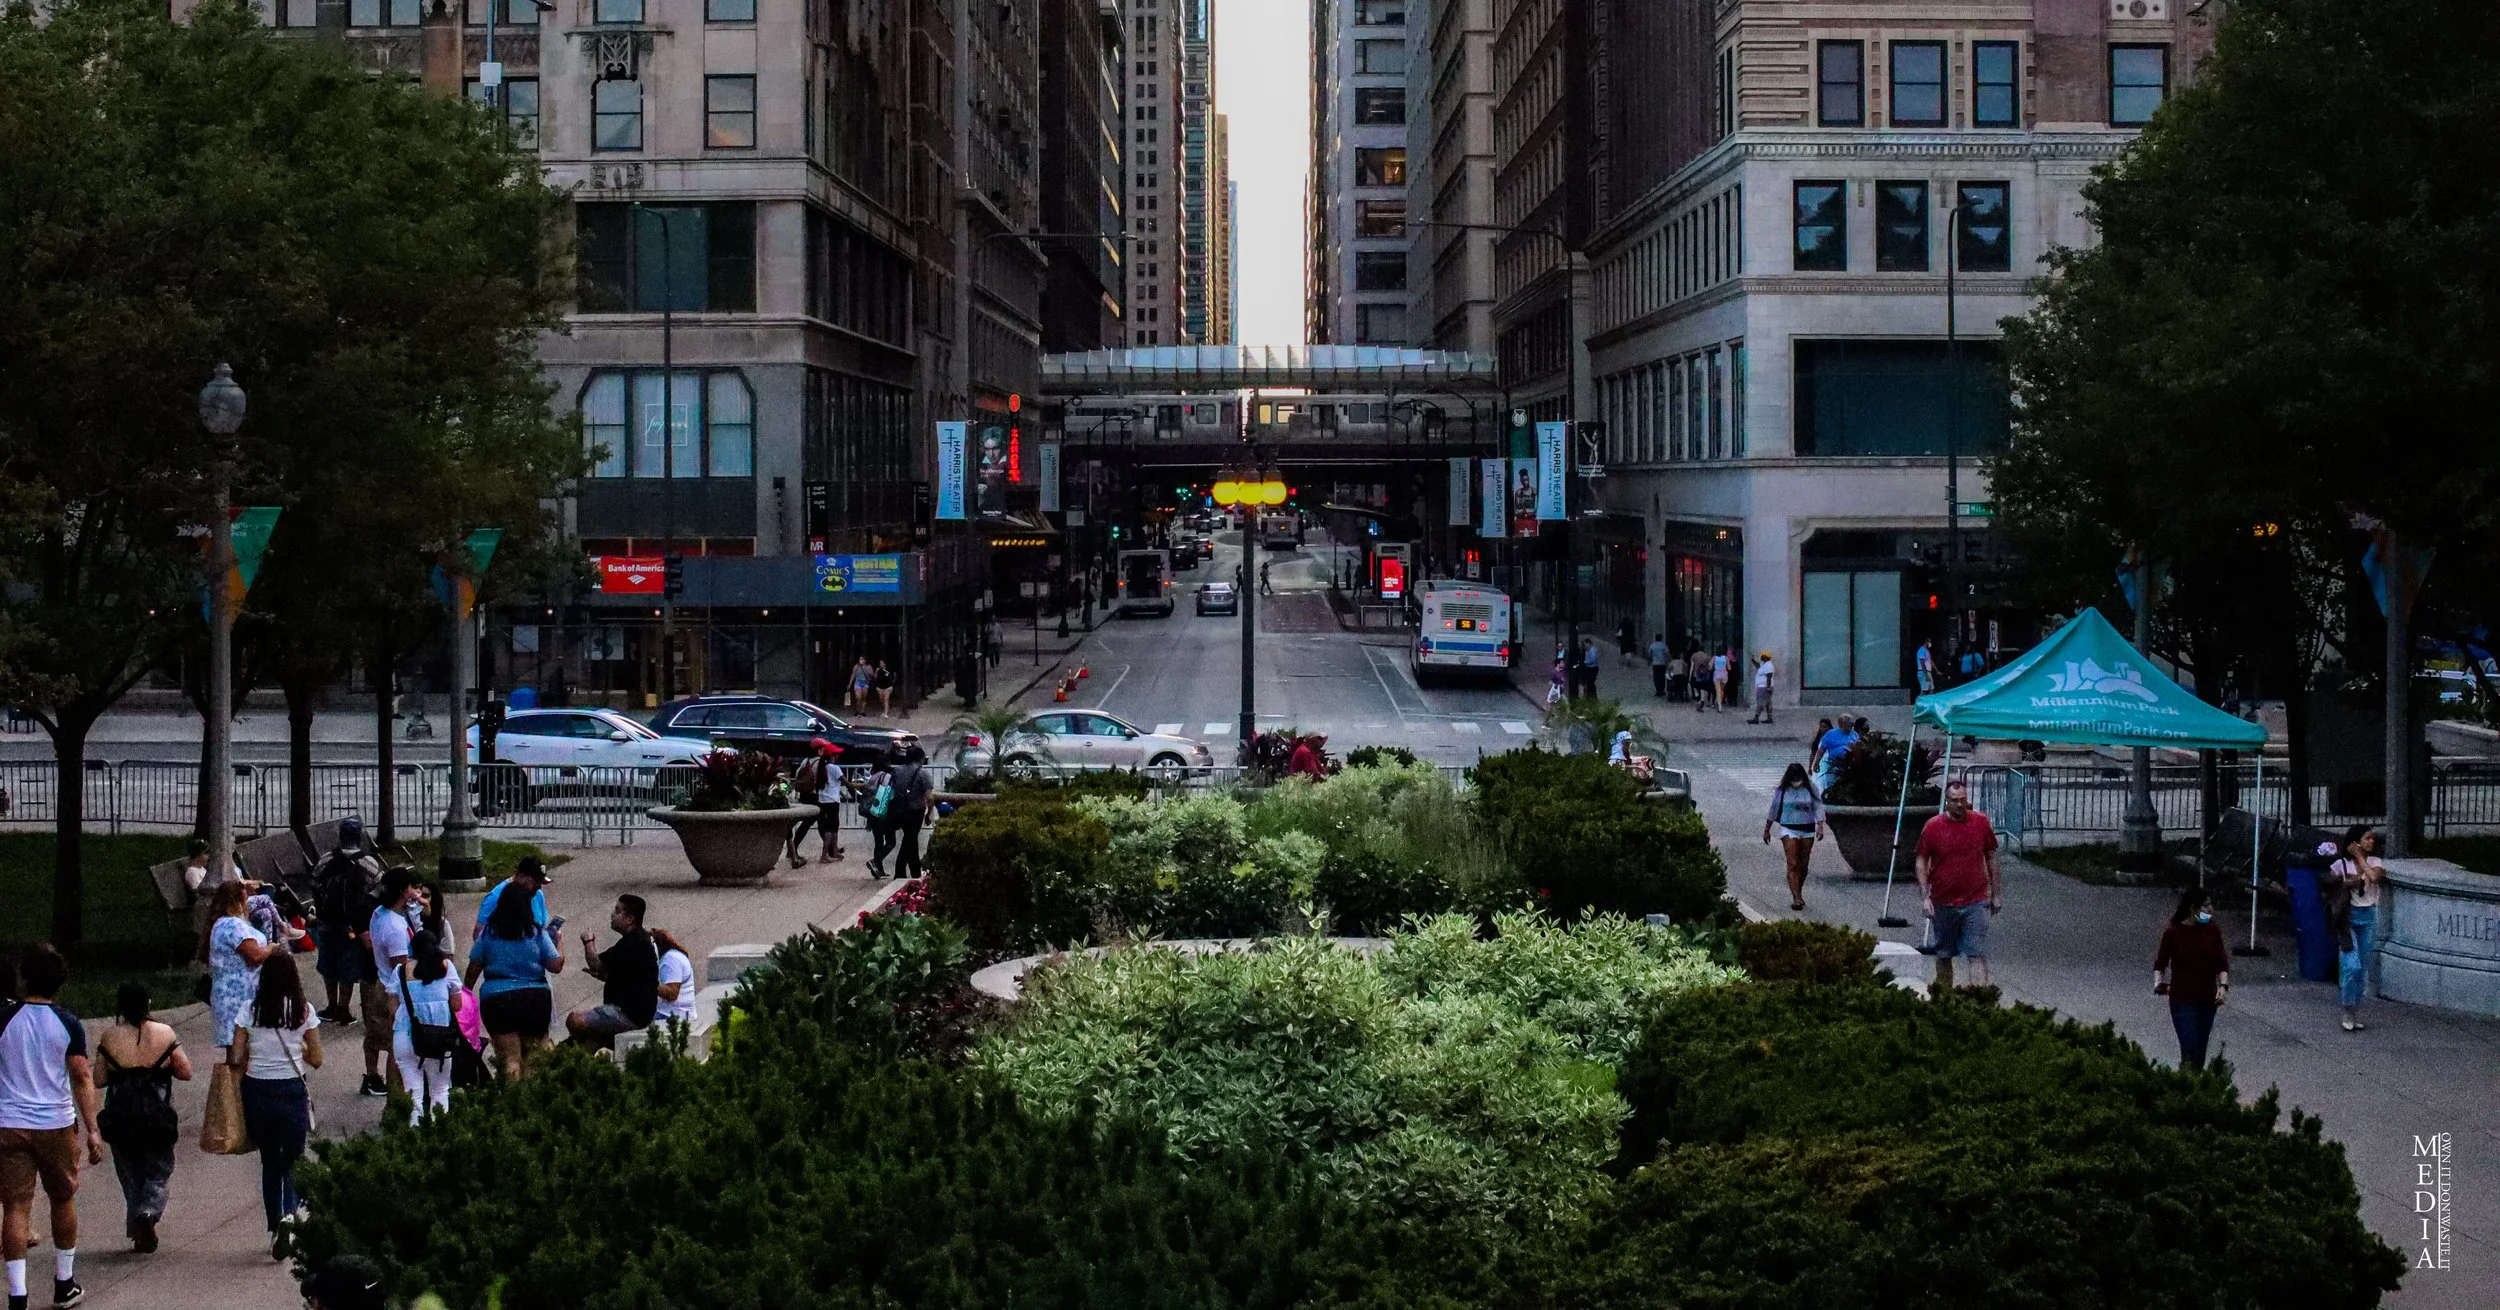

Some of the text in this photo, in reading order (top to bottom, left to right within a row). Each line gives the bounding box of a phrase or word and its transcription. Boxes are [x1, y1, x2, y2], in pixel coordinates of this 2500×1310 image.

[952, 440, 961, 513] HARRIS THEATER
[1553, 440, 1561, 513] HARRIS THEATER
[810, 541, 824, 551] MR
[608, 564, 627, 572] Bank
[627, 564, 635, 572] of
[1969, 584, 1975, 595] 2
[1461, 620, 1471, 629] 56
